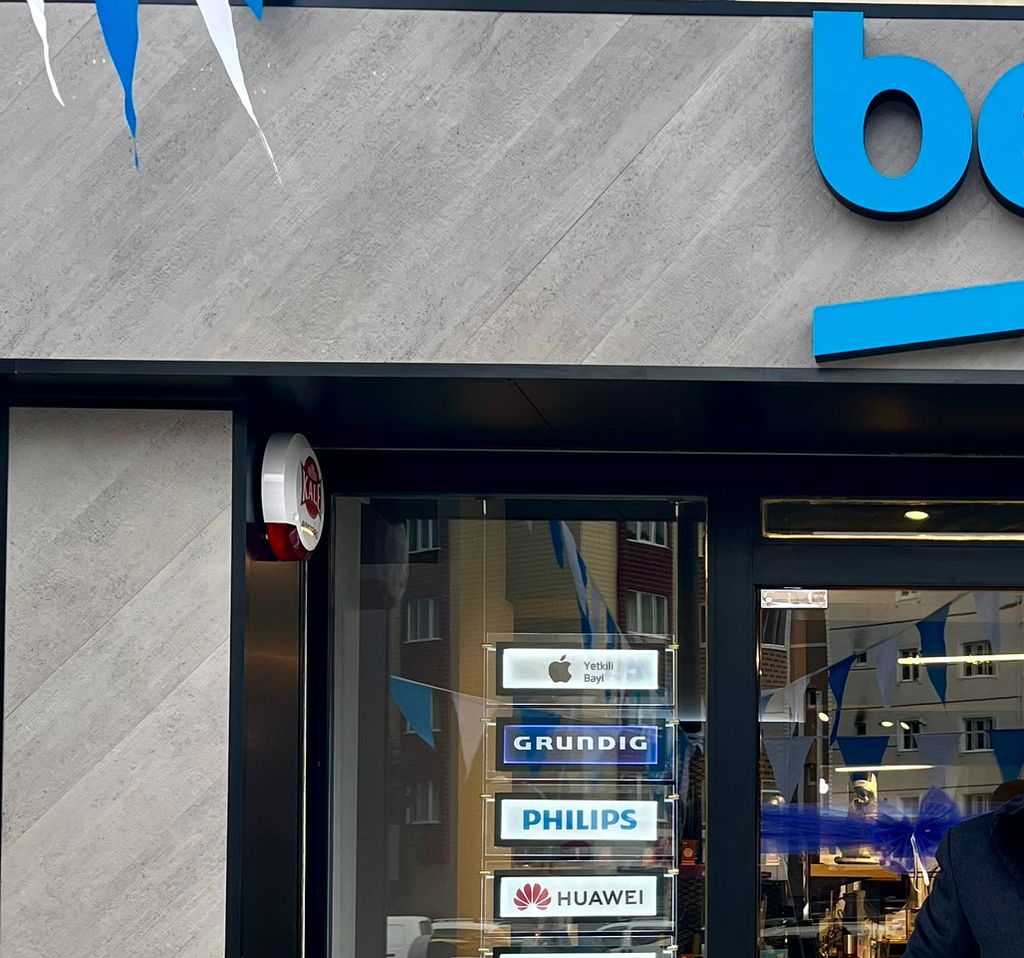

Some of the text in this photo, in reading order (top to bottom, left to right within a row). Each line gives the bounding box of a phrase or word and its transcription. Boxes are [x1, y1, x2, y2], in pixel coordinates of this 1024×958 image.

[583, 661, 614, 671] Yetkili
[583, 673, 605, 685] Bayi
[513, 735, 648, 751] GRUNDIG
[522, 808, 638, 831] PHILIPS
[557, 889, 644, 907] HUAWEI
